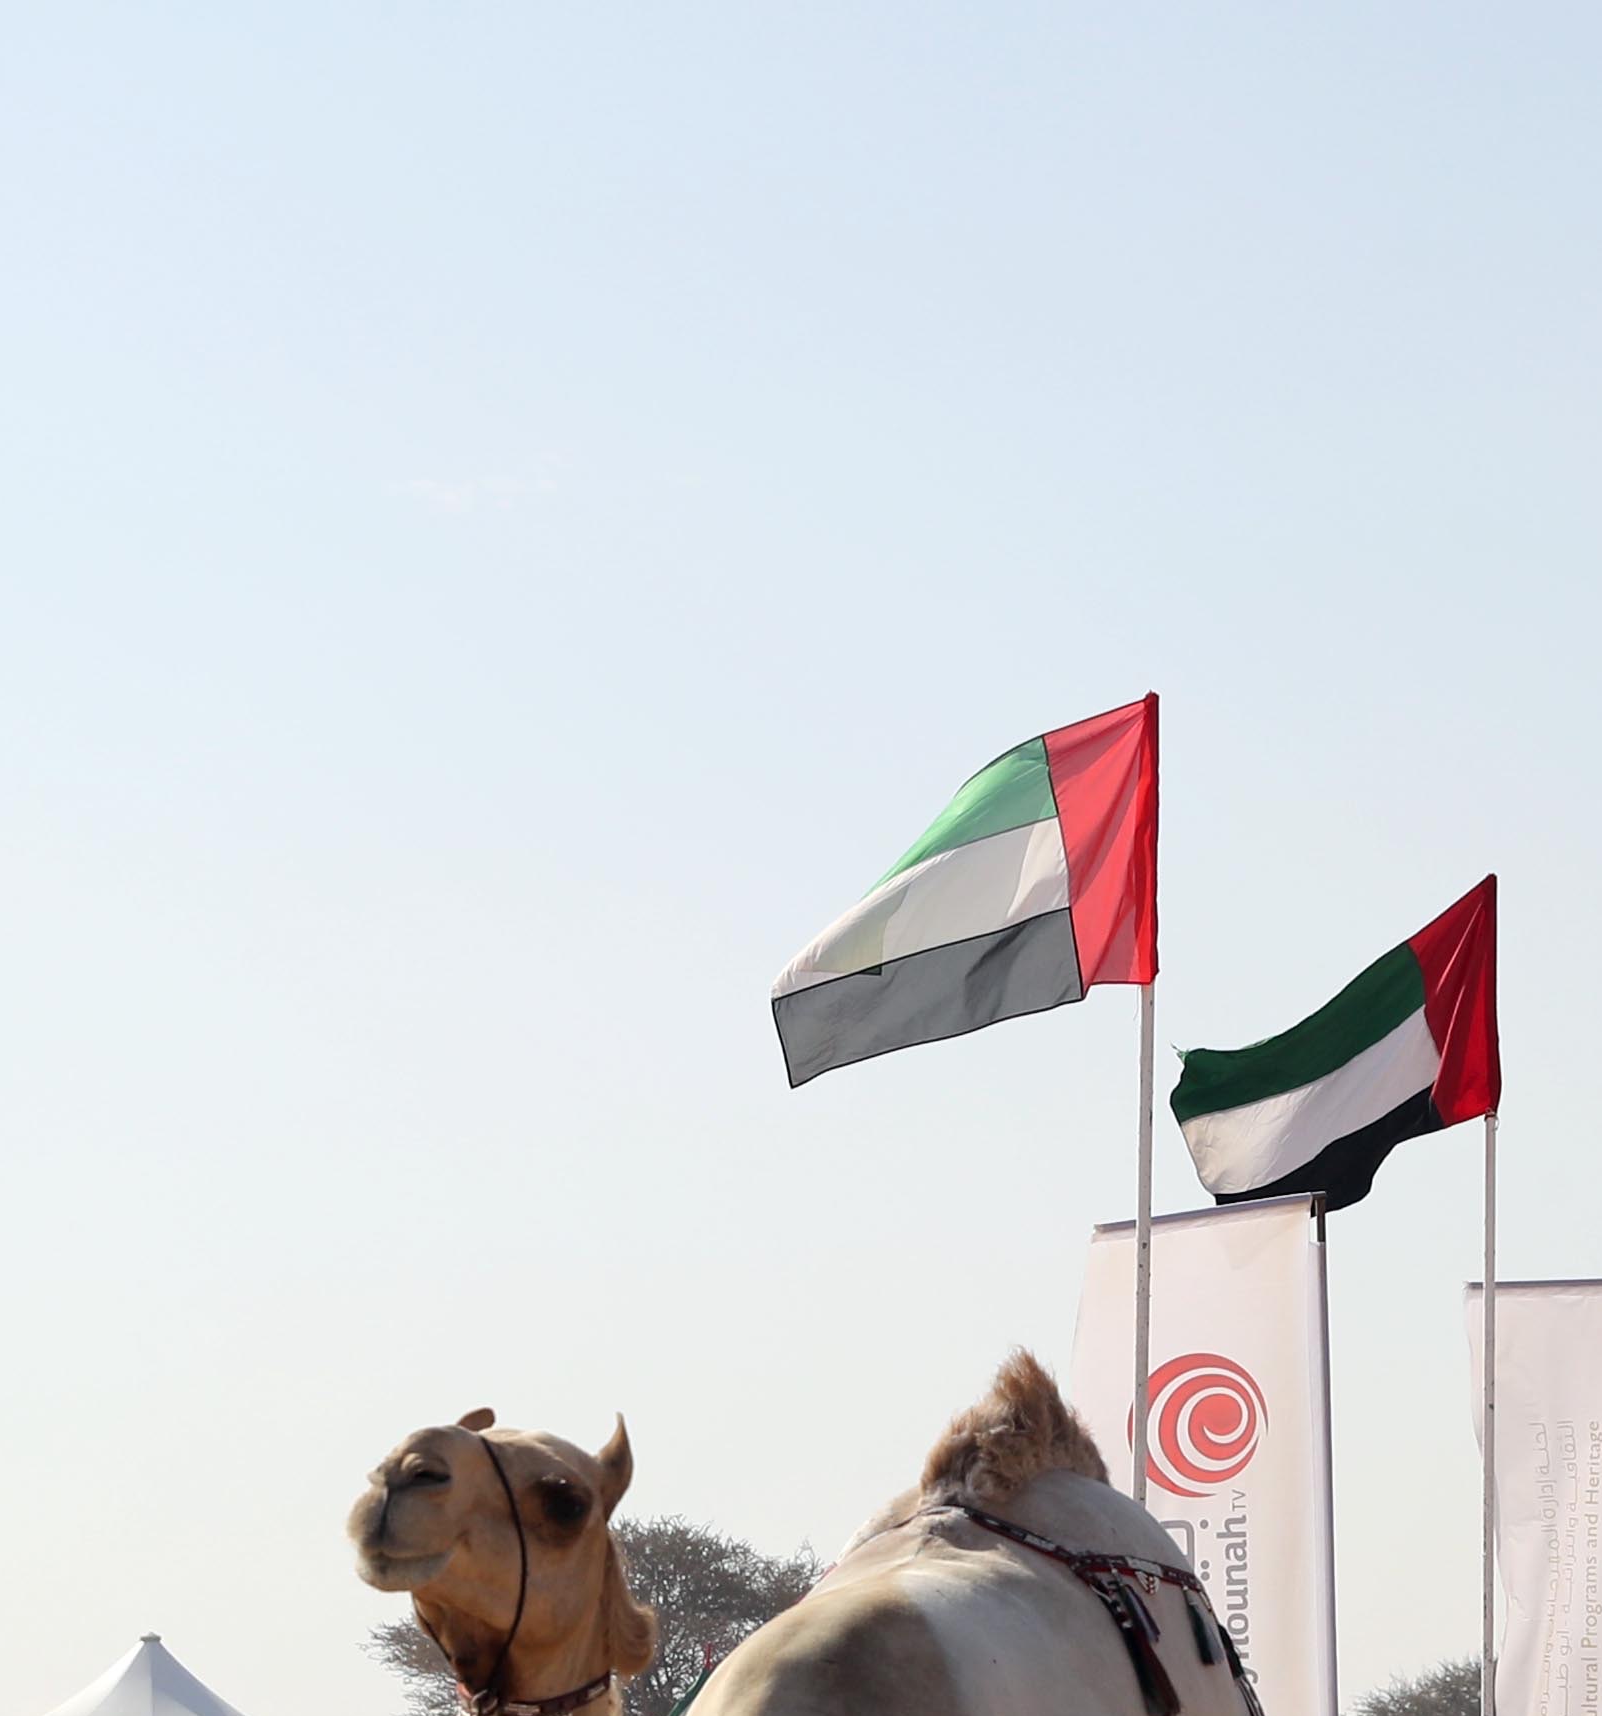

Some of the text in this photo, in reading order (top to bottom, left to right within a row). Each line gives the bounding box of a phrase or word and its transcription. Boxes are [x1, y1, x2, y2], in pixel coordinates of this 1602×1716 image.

[1231, 1489, 1247, 1512] TV
[1584, 1514, 1599, 1548] and
[1582, 1556, 1602, 1648] Programs
